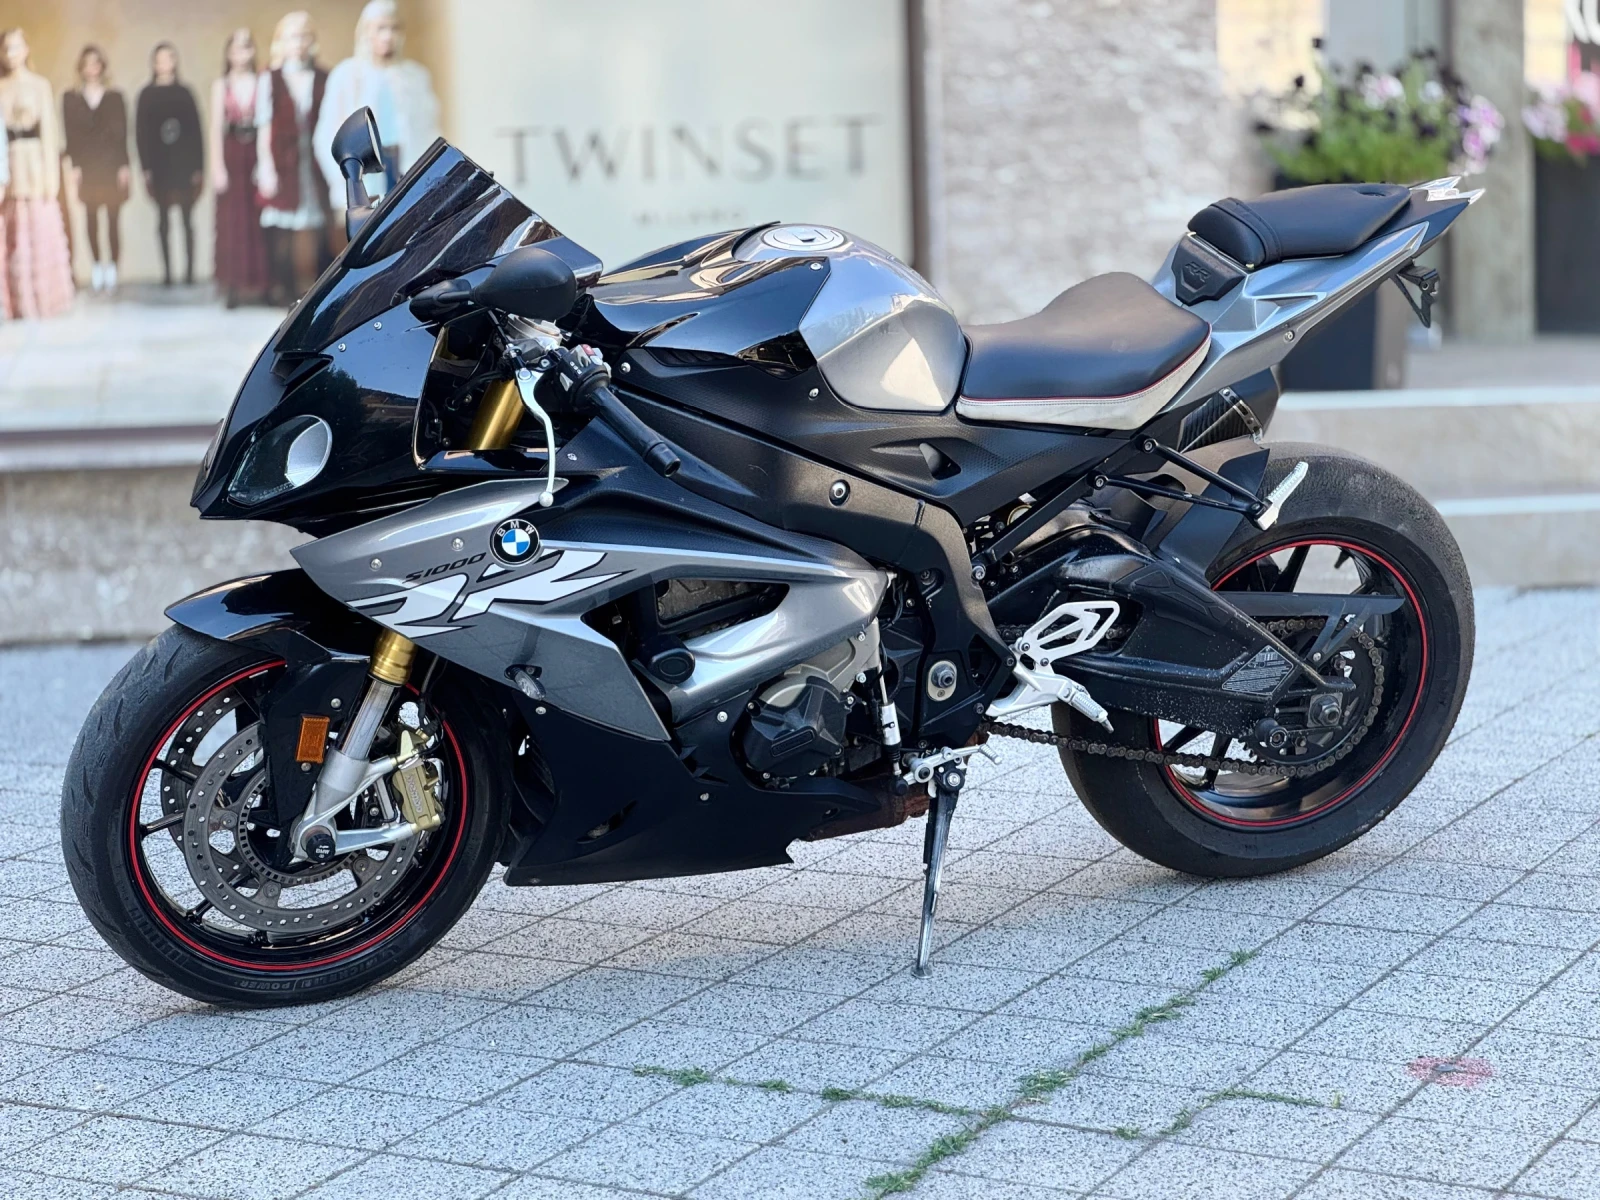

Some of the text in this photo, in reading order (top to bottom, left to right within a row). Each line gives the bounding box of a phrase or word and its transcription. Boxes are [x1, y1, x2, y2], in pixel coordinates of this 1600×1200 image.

[494, 112, 882, 189] TWINSET
[496, 520, 535, 537] BMW
[403, 552, 487, 583] S1000
[240, 979, 291, 991] POWER
